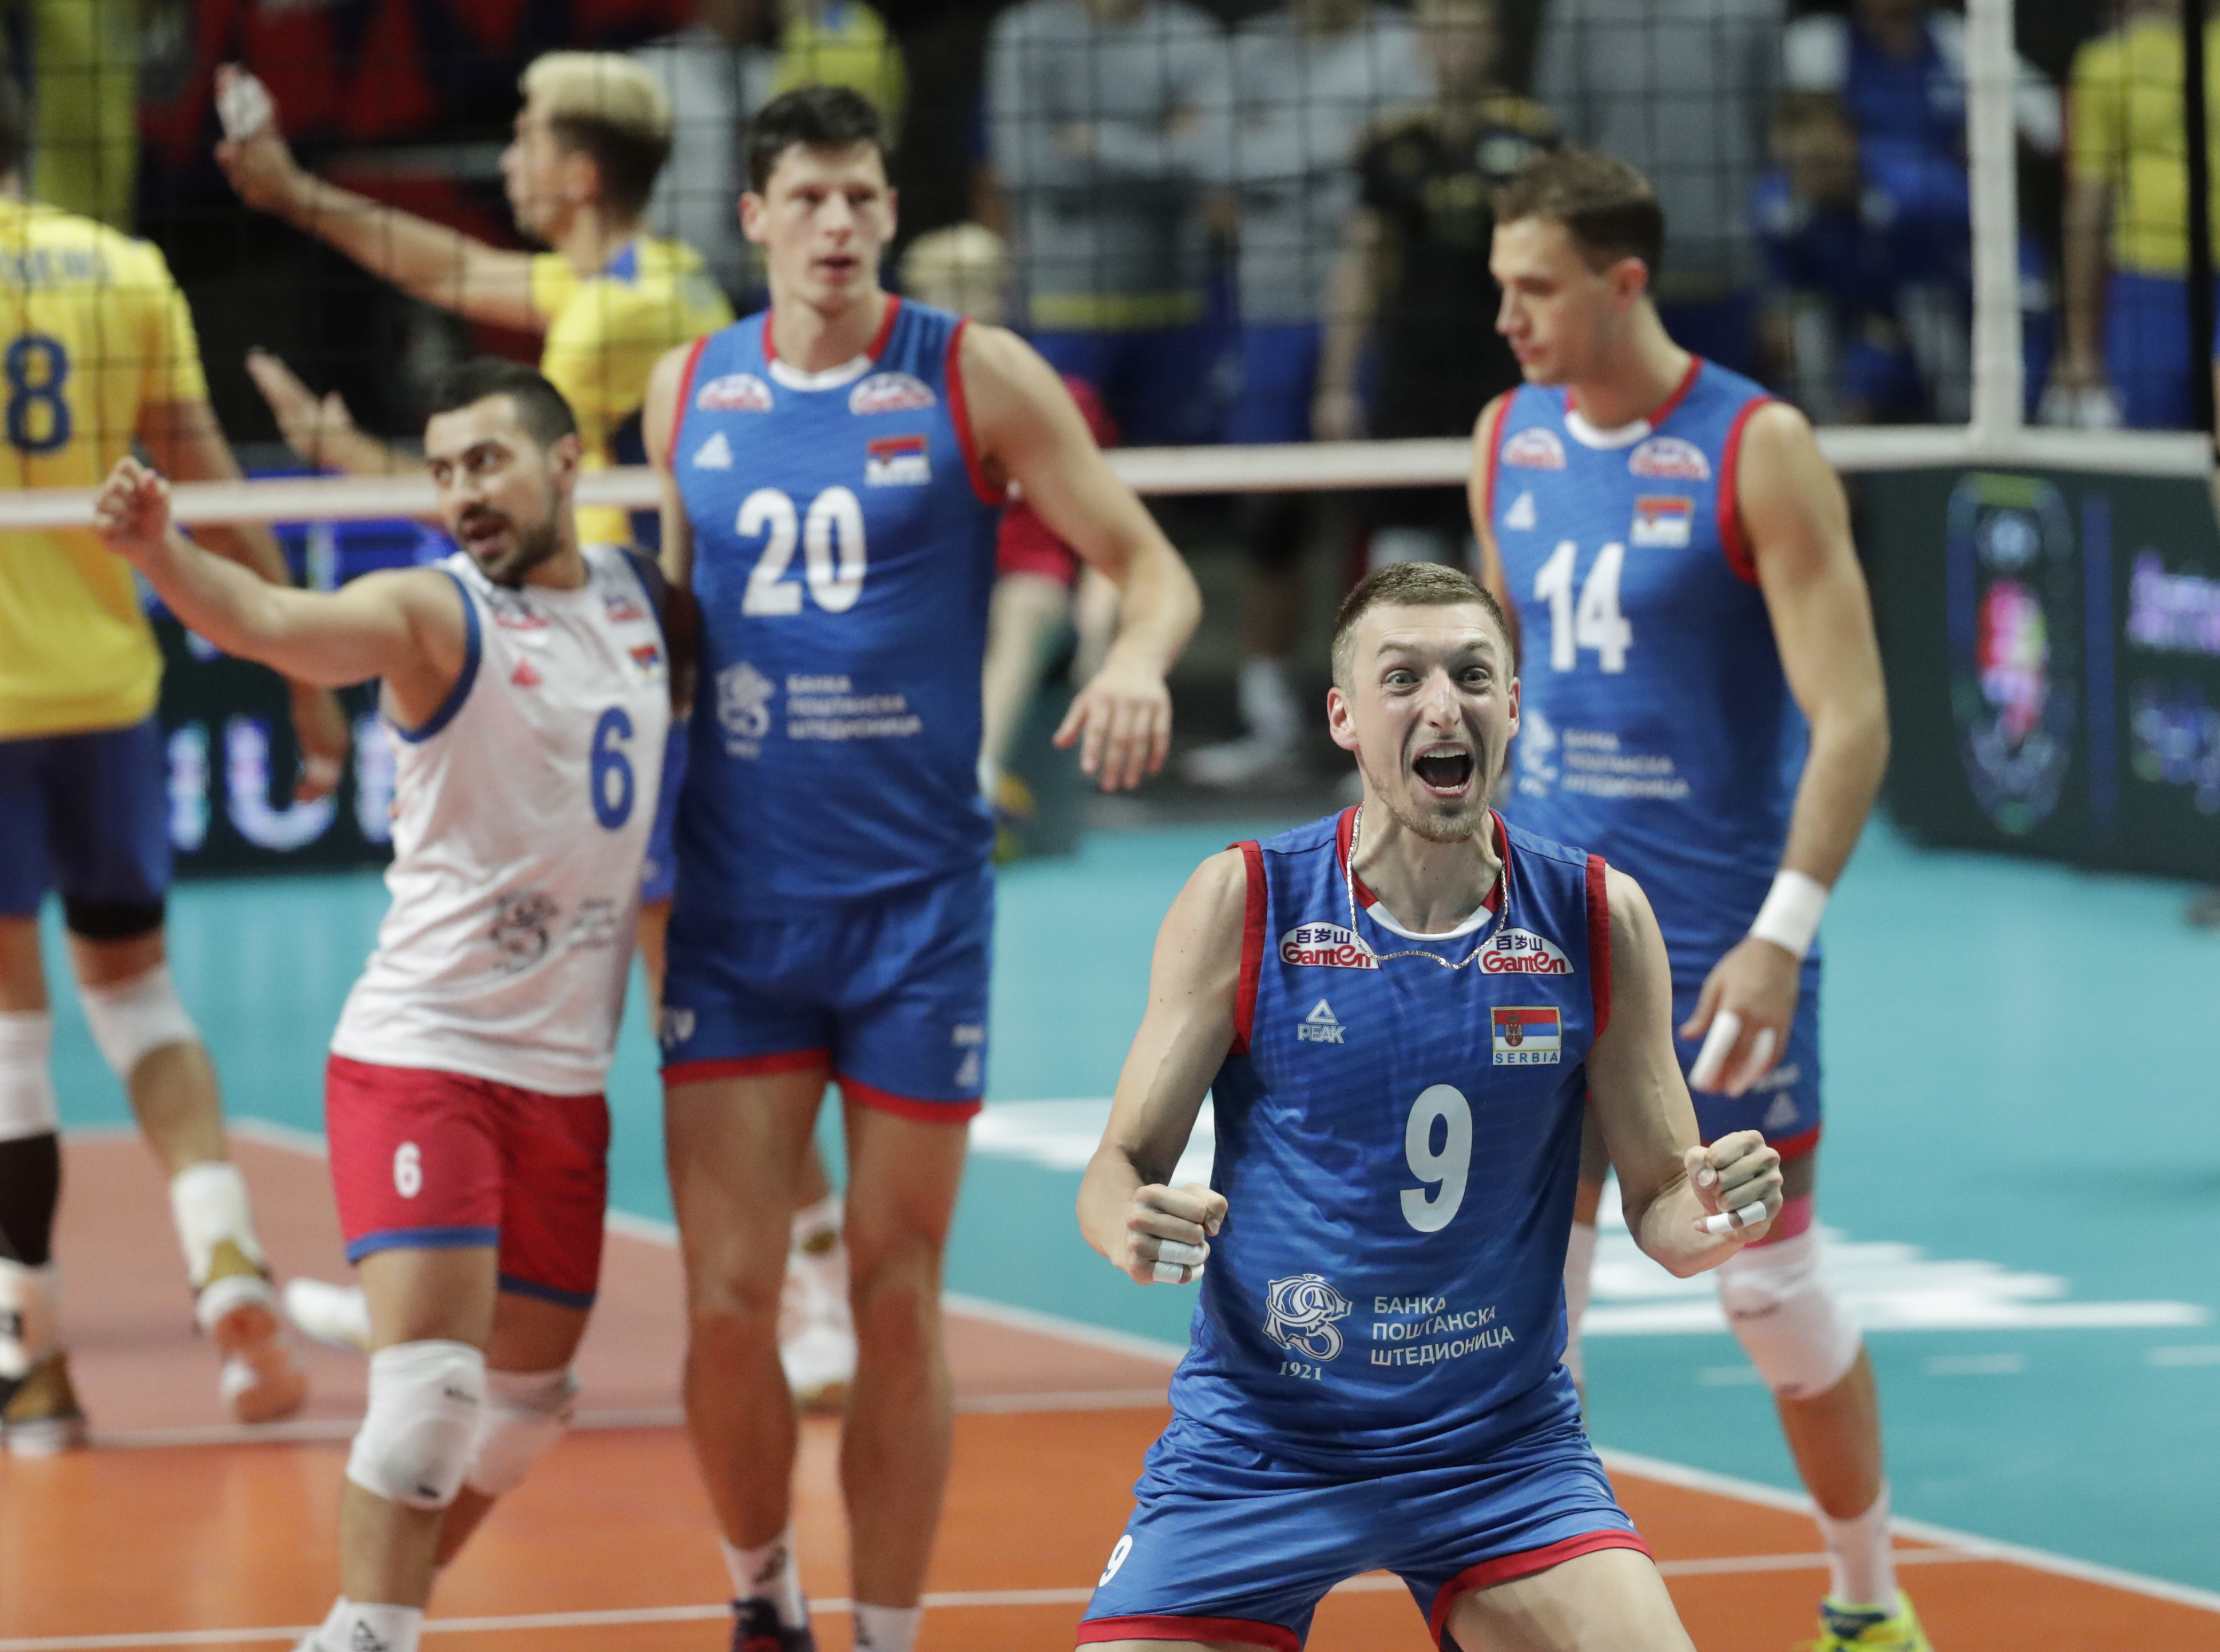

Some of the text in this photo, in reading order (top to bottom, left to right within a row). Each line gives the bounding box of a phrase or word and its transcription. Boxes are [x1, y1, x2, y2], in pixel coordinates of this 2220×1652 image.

[5, 334, 72, 454] 8
[736, 486, 866, 616] 20
[1533, 541, 1632, 673] 14
[590, 707, 634, 830] 6
[1296, 928, 1350, 944] 百岁山
[1496, 934, 1543, 951] 百岁山
[1297, 1023, 1346, 1044] PEAK
[1495, 1052, 1558, 1064] SERBIA
[393, 1141, 423, 1198] 6
[1400, 1084, 1473, 1232] 9
[1373, 1305, 1496, 1341] ПОШТАНСКА
[1374, 1296, 1446, 1315] БАНКА
[1370, 1326, 1515, 1366] ШТЕДИОНИЦА
[1278, 1361, 1322, 1381] 1921
[1098, 1534, 1133, 1587] 9
